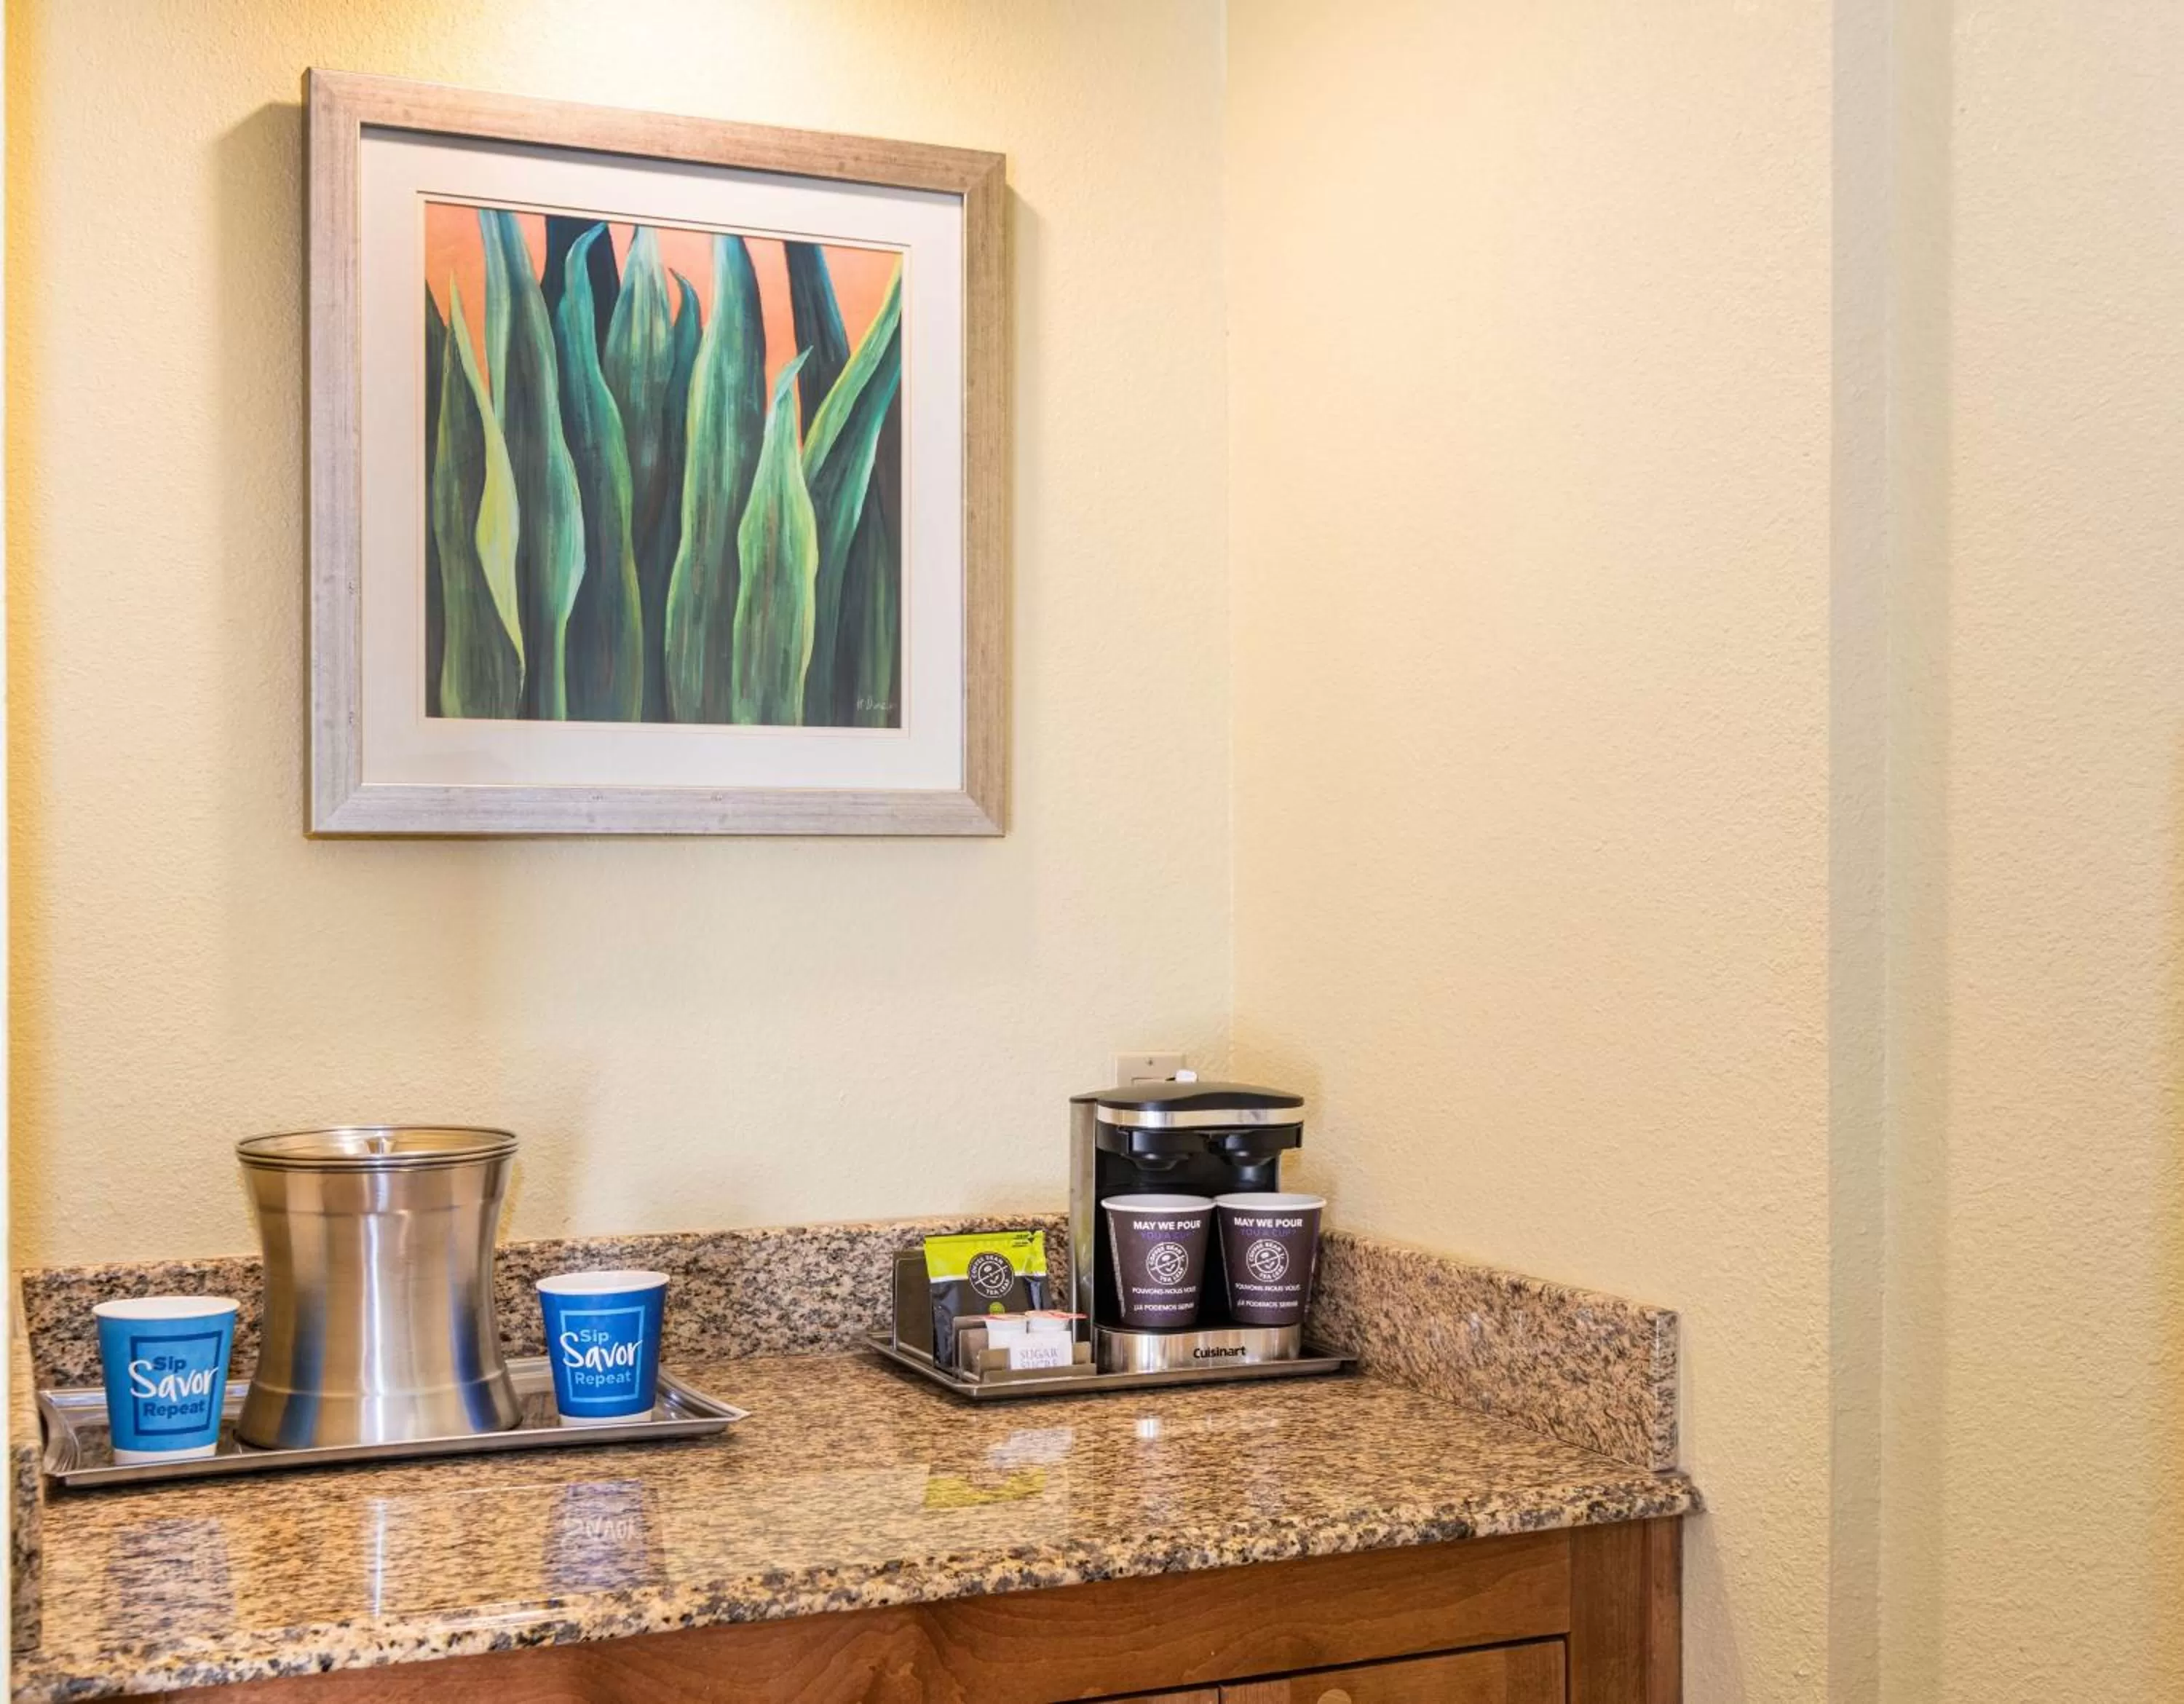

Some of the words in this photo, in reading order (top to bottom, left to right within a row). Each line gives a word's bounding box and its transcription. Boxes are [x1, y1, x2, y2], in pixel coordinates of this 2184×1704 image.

[1133, 1220, 1155, 1230] MAY
[1158, 1221, 1175, 1230] WE
[1234, 1217, 1254, 1227] MAY
[1256, 1218, 1273, 1228] WE
[1275, 1218, 1302, 1228] POUR
[579, 1329, 610, 1345] Sip
[560, 1331, 644, 1372] Savor
[1193, 1346, 1246, 1358] Cuisinart
[153, 1355, 186, 1373] Sip
[127, 1360, 218, 1403] Savor
[574, 1370, 632, 1388] Repeat
[143, 1400, 206, 1419] Repeat
